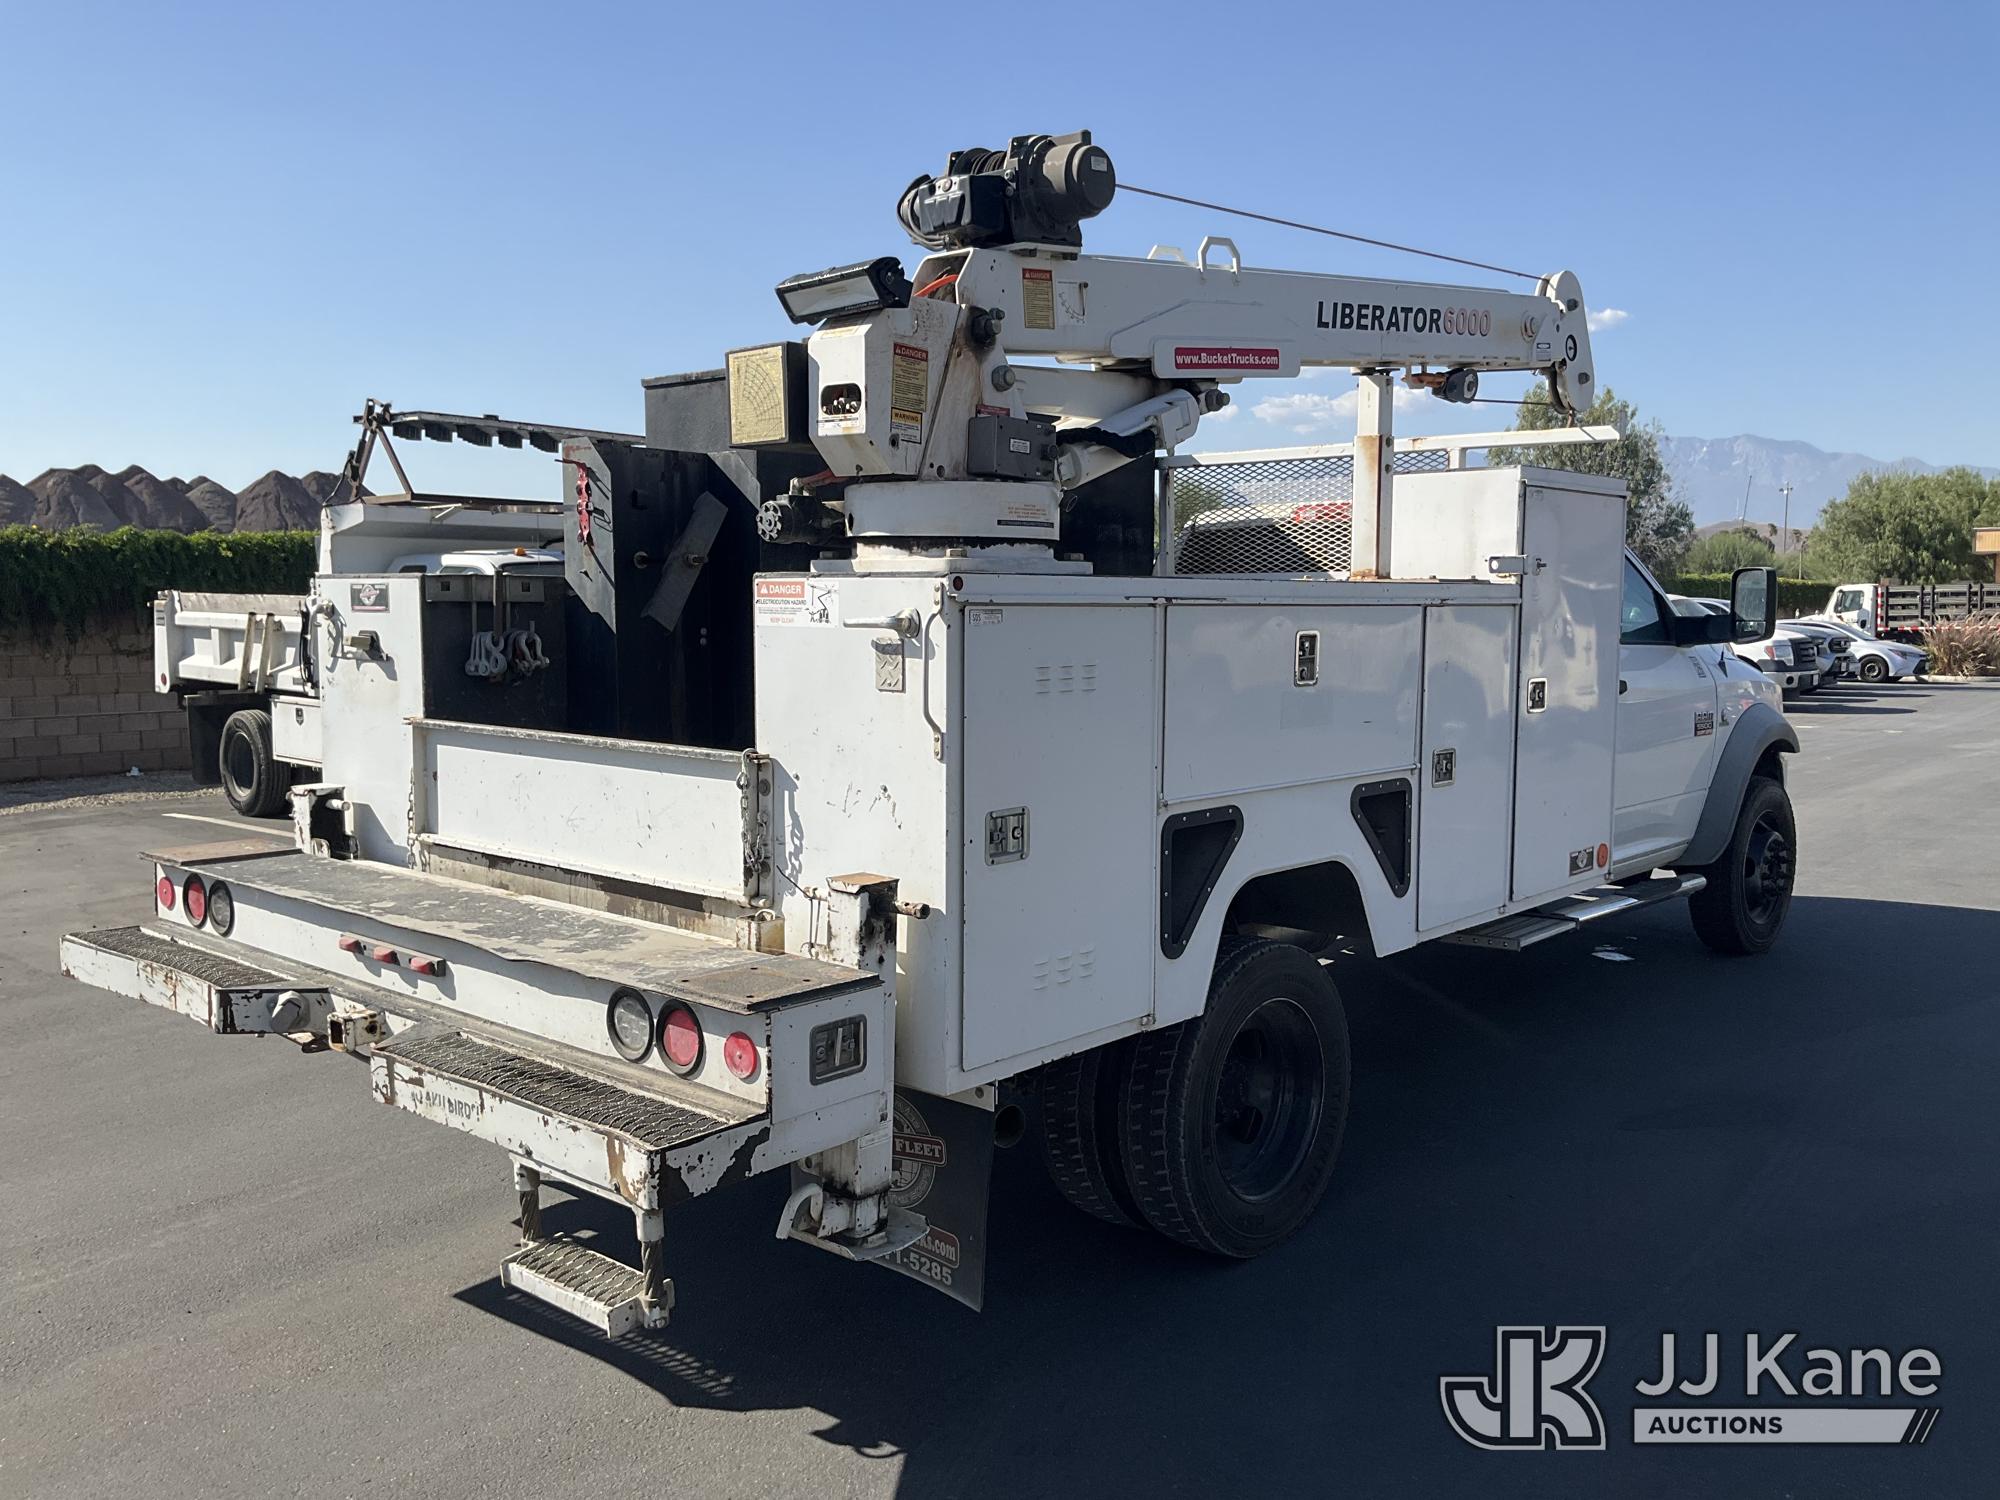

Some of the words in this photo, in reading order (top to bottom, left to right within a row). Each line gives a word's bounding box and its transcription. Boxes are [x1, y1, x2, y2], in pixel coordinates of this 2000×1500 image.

[901, 347, 927, 359] DANGER
[1175, 352, 1279, 365] www.BucketTrucks.com
[769, 584, 802, 595] DANGER
[895, 1137, 941, 1159] FLEET
